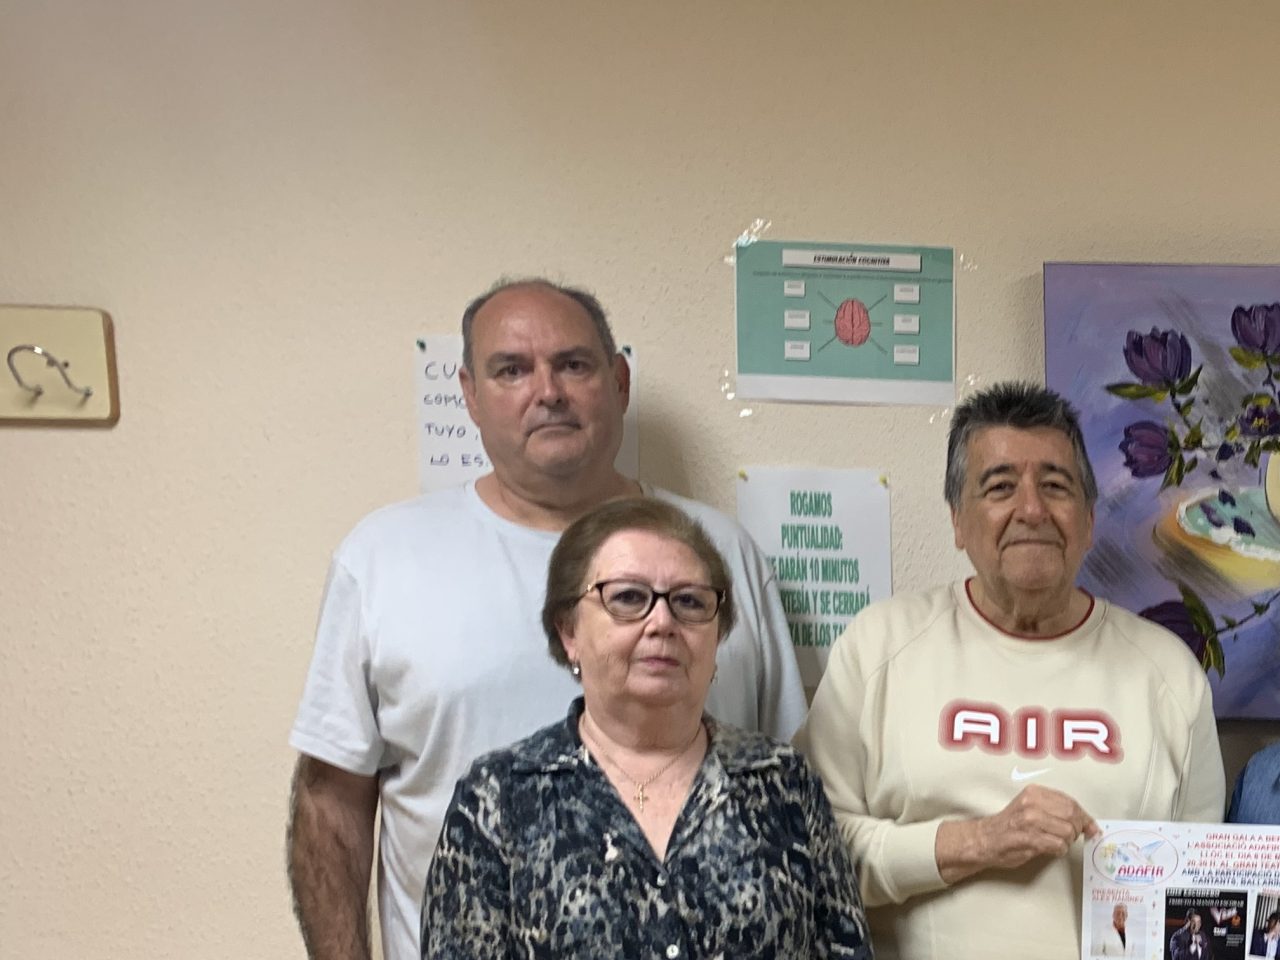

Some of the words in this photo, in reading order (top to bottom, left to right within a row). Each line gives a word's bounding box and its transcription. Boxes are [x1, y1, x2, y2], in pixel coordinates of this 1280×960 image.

[813, 251, 857, 265] ESTIMULACIÓN
[858, 256, 891, 266] COGNITIVA
[790, 490, 832, 518] ROGAMOS
[781, 523, 843, 550] PUNTUALIDAD:
[779, 551, 808, 582] DARÁN
[810, 558, 820, 582] 10
[821, 558, 860, 584] MINUTOS
[812, 591, 819, 616] Y
[820, 591, 832, 616] SE
[802, 623, 814, 646] DE
[815, 623, 832, 647] LOS
[947, 706, 1117, 758] AIR
[1117, 864, 1165, 878] ADAFIR
